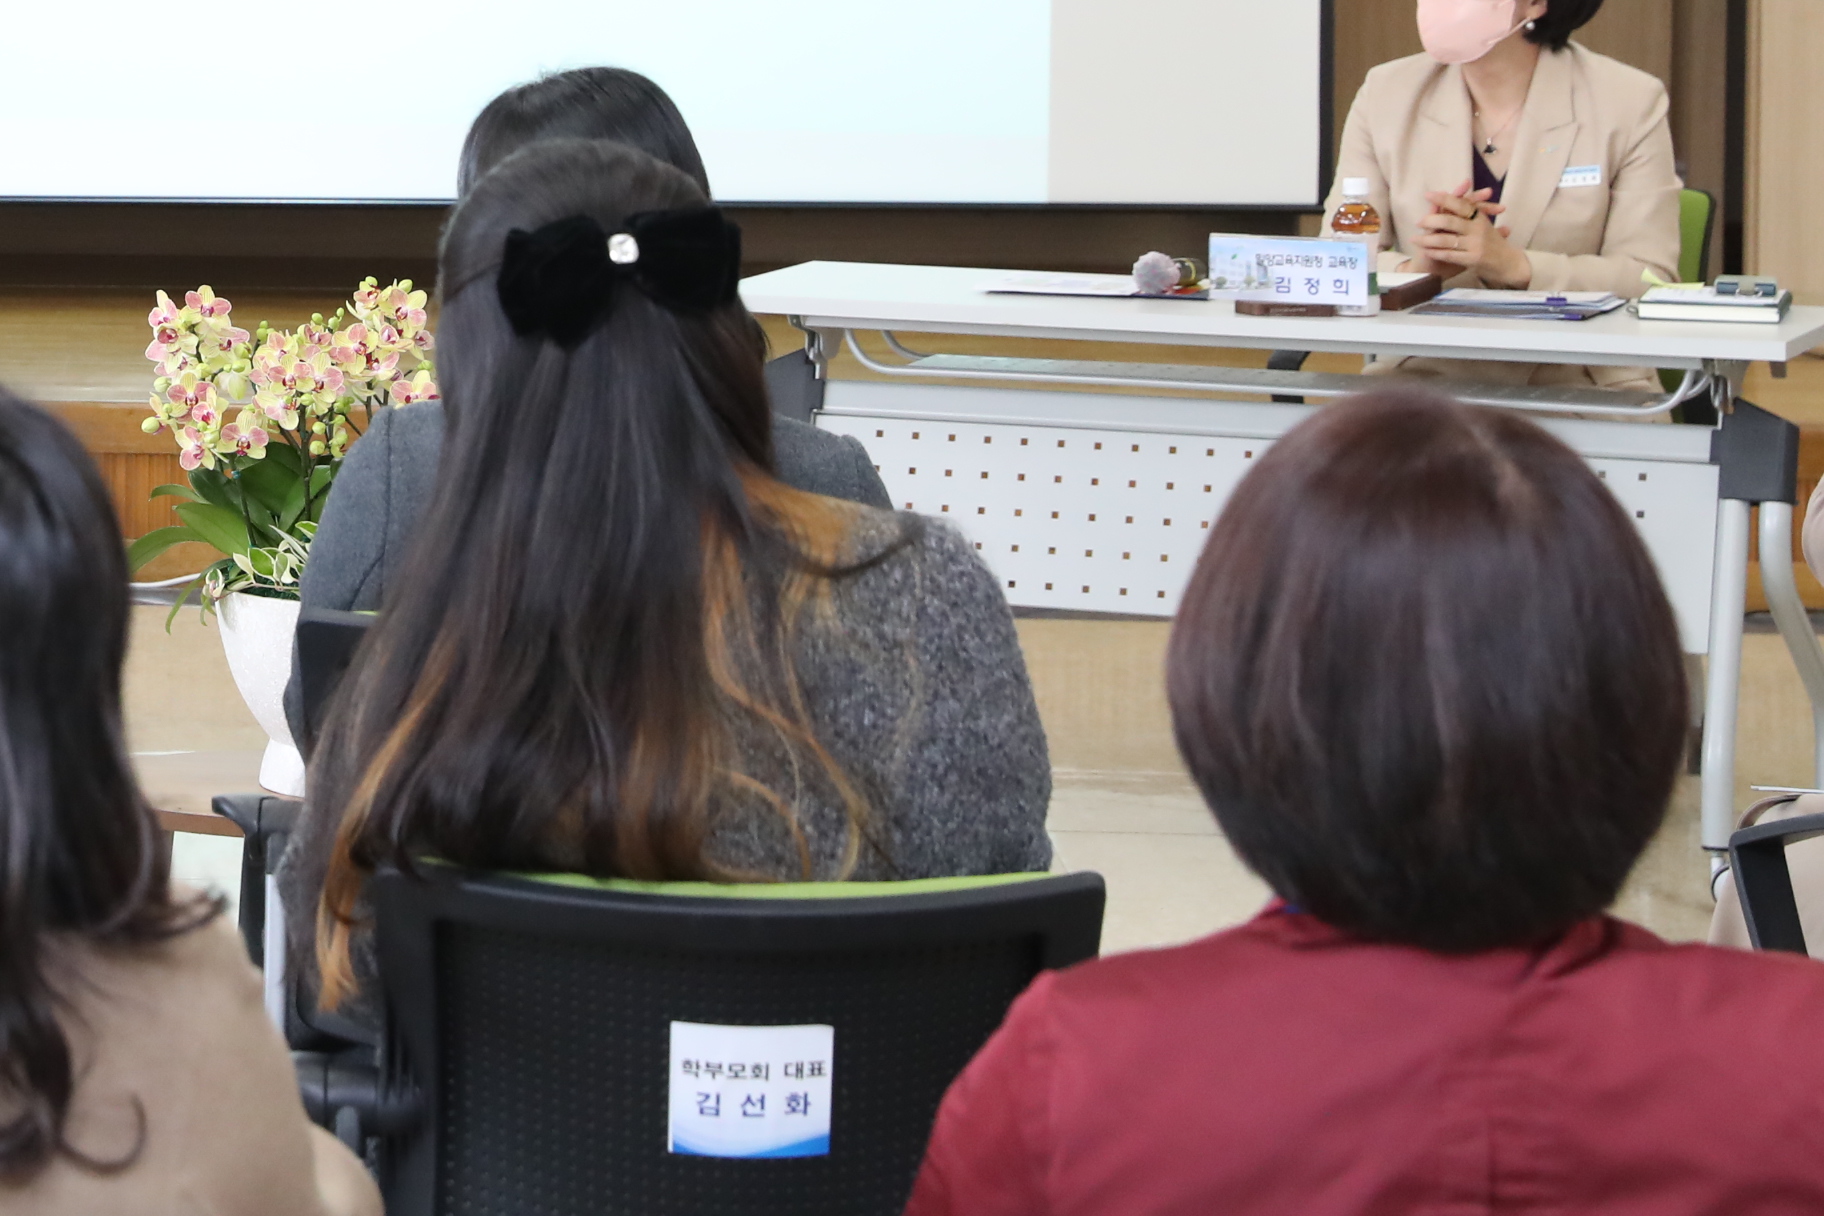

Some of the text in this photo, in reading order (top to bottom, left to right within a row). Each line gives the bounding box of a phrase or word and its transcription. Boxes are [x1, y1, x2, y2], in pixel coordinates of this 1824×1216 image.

[1328, 255, 1359, 270] 교육장
[681, 1058, 827, 1081] 학부모회 대표
